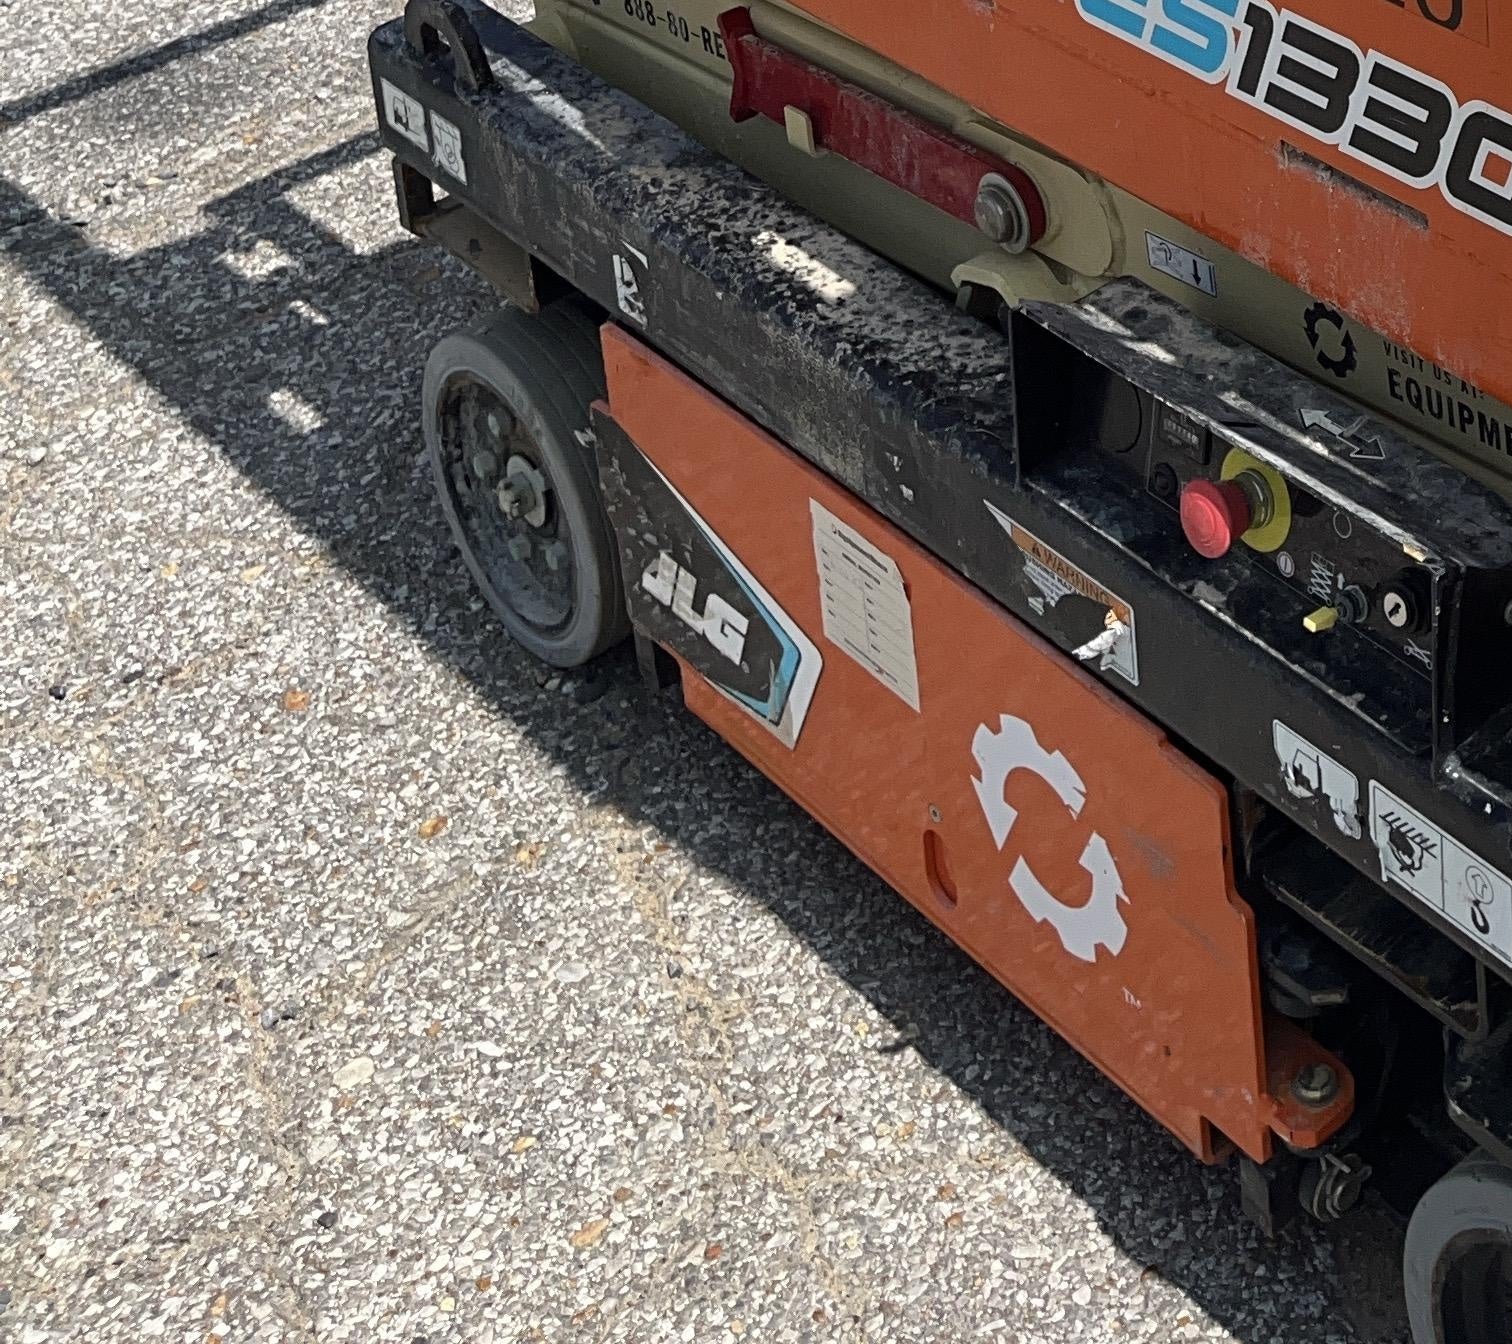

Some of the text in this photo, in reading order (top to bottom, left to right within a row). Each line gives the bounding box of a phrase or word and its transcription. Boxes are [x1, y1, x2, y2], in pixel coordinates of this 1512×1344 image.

[1383, 340, 1424, 373] VISIT
[1044, 544, 1111, 604] WARNING
[642, 551, 749, 667] JLG
